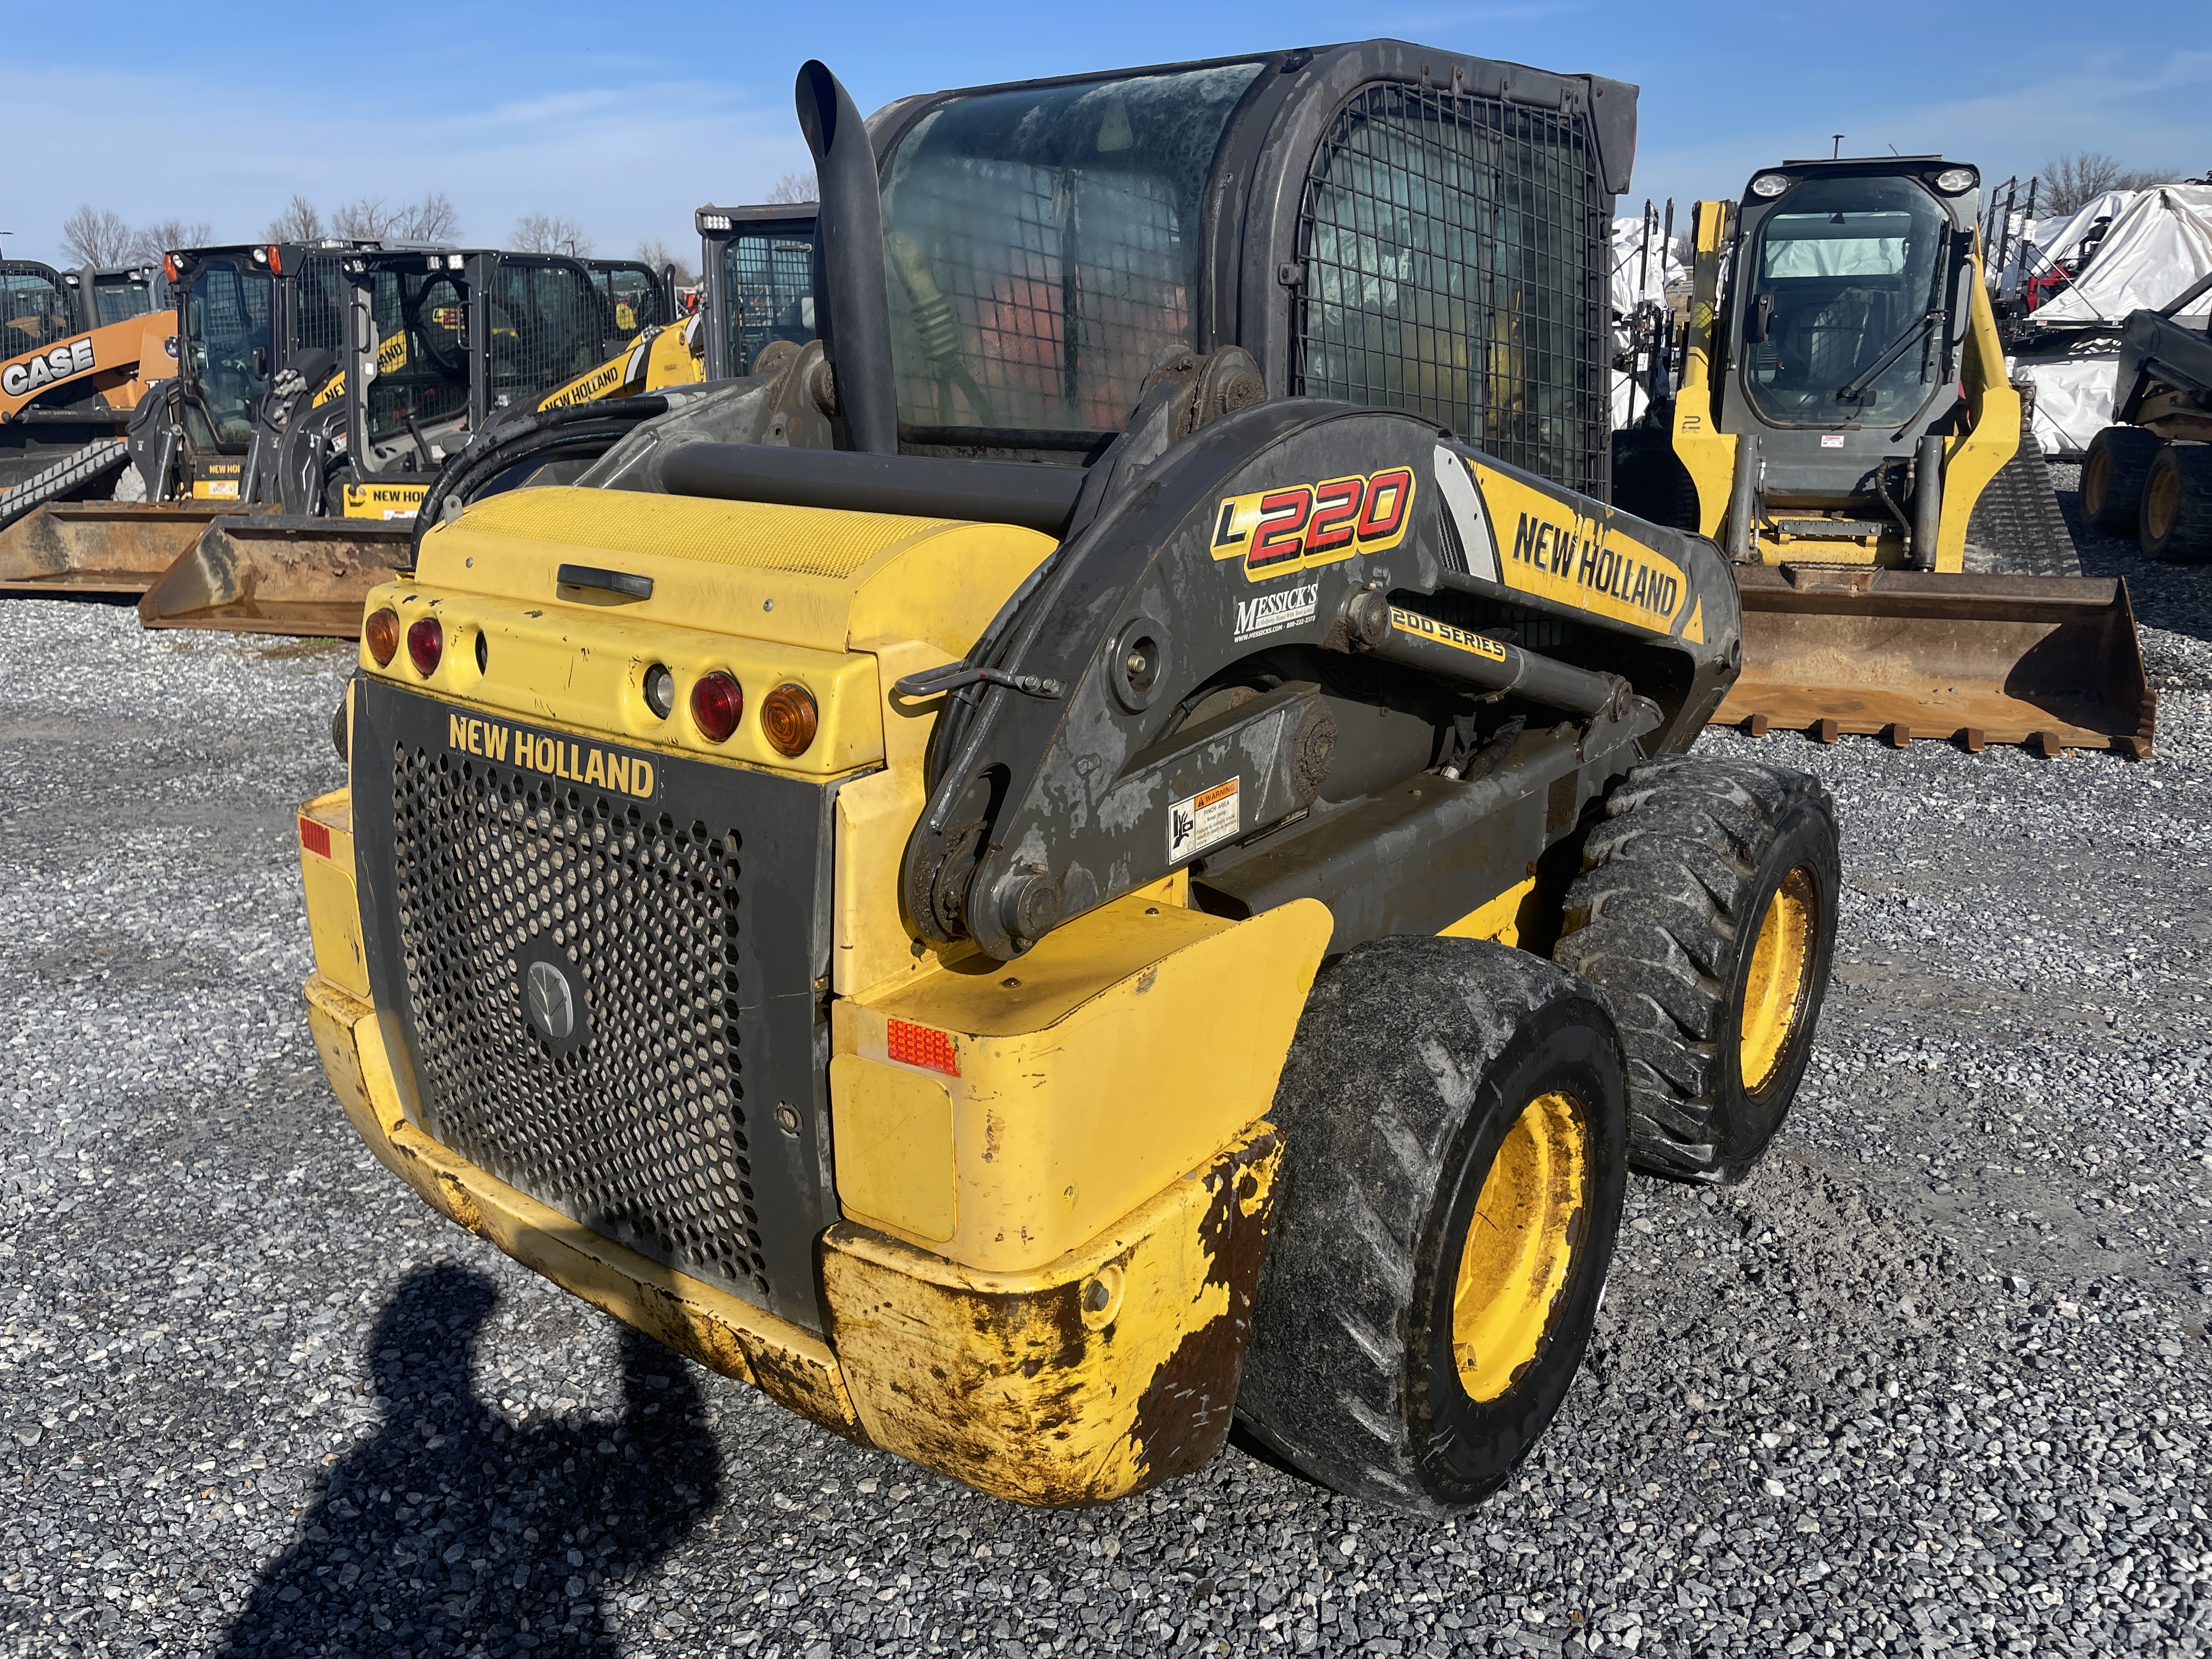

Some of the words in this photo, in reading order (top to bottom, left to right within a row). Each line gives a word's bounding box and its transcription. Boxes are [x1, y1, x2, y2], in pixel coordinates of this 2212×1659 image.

[2, 336, 95, 396] CASE
[572, 366, 618, 403] HOLLAND
[373, 490, 400, 501] NEW
[1212, 470, 1413, 571] L220
[1513, 510, 1578, 580] NEW
[1576, 538, 1677, 618] HOLLAND
[1234, 583, 1318, 635] MESSICK'S
[1234, 624, 1283, 643] WWW.MESSICKS.COM
[1393, 609, 1434, 634] 200
[1439, 624, 1504, 656] SERIES
[449, 713, 509, 761] NEW
[515, 730, 654, 799] HOLLAND
[1204, 806, 1216, 816] PINCH
[1218, 800, 1229, 809] AREA
[1205, 784, 1234, 803] WARNING
[1197, 826, 1209, 835] Failure
[1213, 819, 1225, 827] comply
[1226, 813, 1235, 821] could
